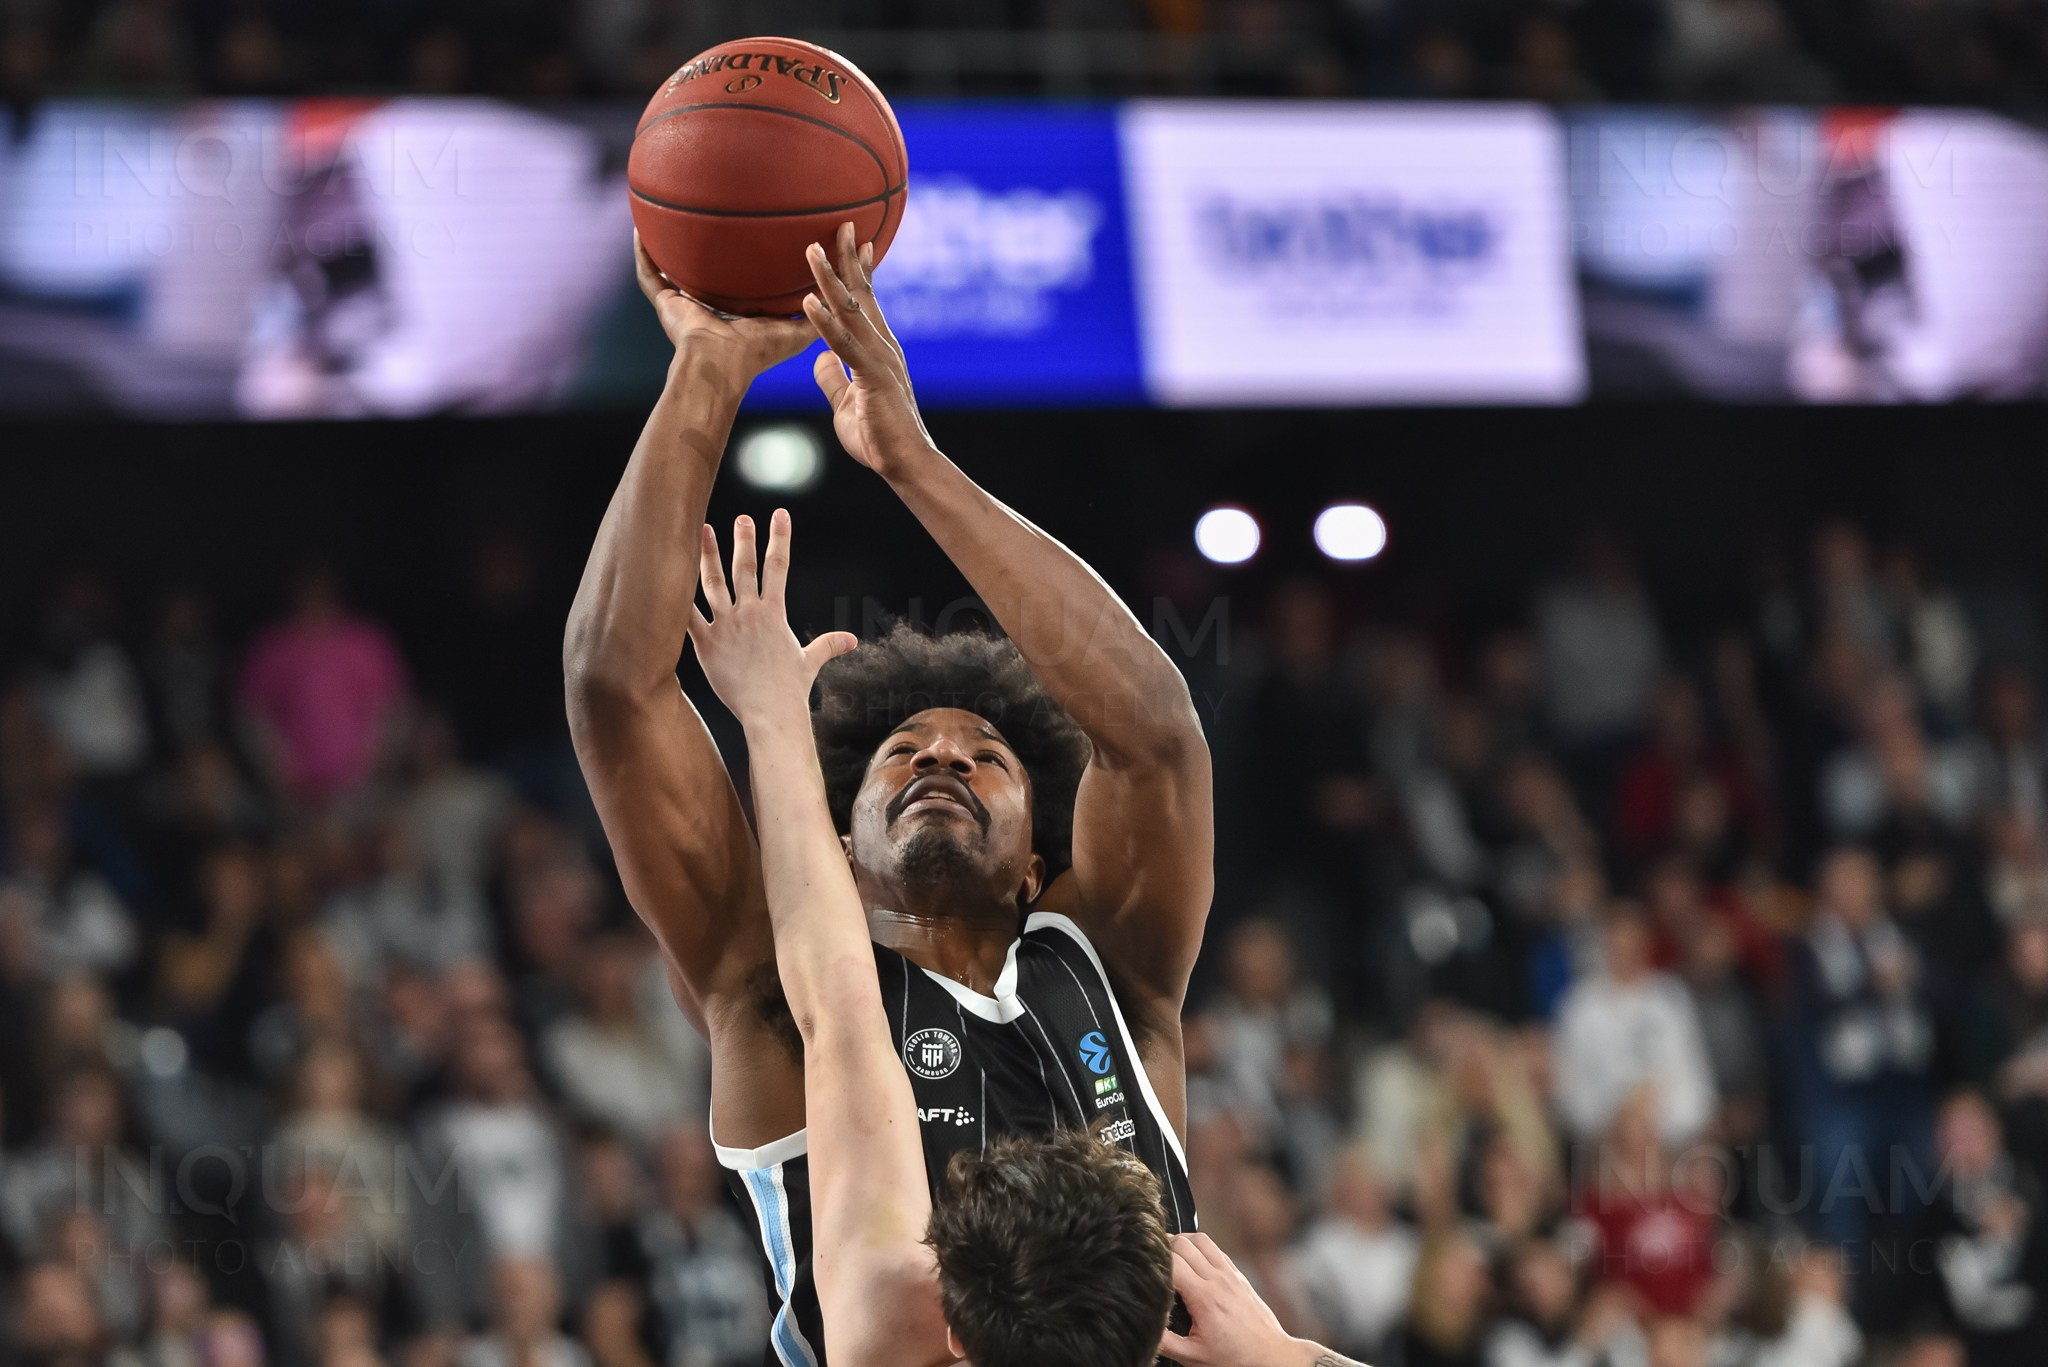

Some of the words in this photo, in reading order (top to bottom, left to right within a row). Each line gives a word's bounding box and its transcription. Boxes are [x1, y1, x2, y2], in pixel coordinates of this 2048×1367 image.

[665, 54, 848, 104] SPALDING
[907, 1032, 930, 1052] VEOLIA
[933, 1031, 958, 1054] TOWERS
[915, 1065, 949, 1076] HAMBURG
[1095, 1092, 1126, 1110] EuroCup
[917, 1107, 956, 1122] AFT
